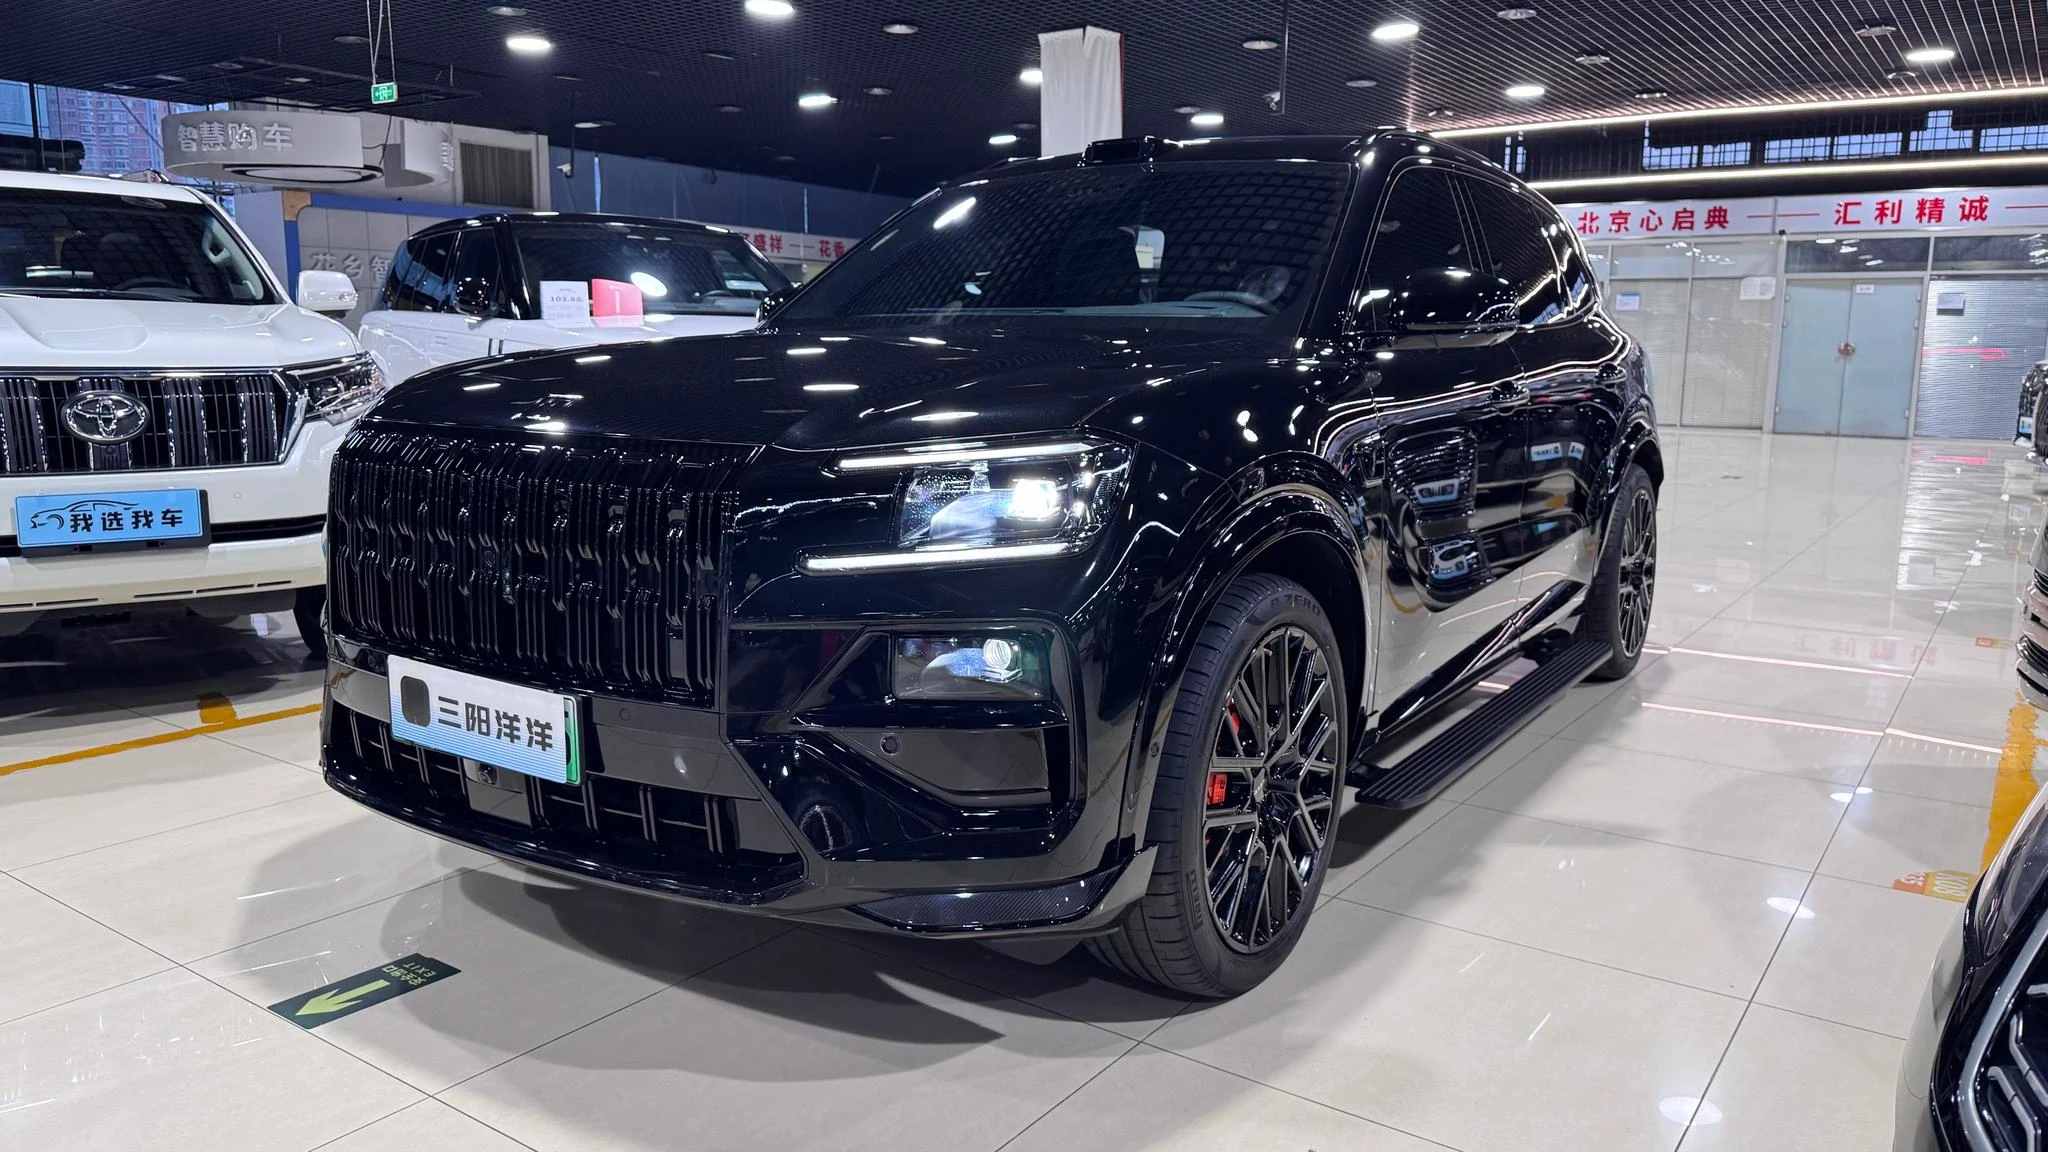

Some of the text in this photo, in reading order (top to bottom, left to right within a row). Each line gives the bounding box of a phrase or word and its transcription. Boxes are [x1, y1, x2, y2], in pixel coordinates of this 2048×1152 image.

[178, 121, 294, 152] 智慧购车
[1577, 195, 1990, 234] 北京心启典 汇利精诚
[70, 508, 183, 533] 我选我车
[438, 695, 553, 752] 三阳洋洋
[402, 962, 437, 978] EXIT
